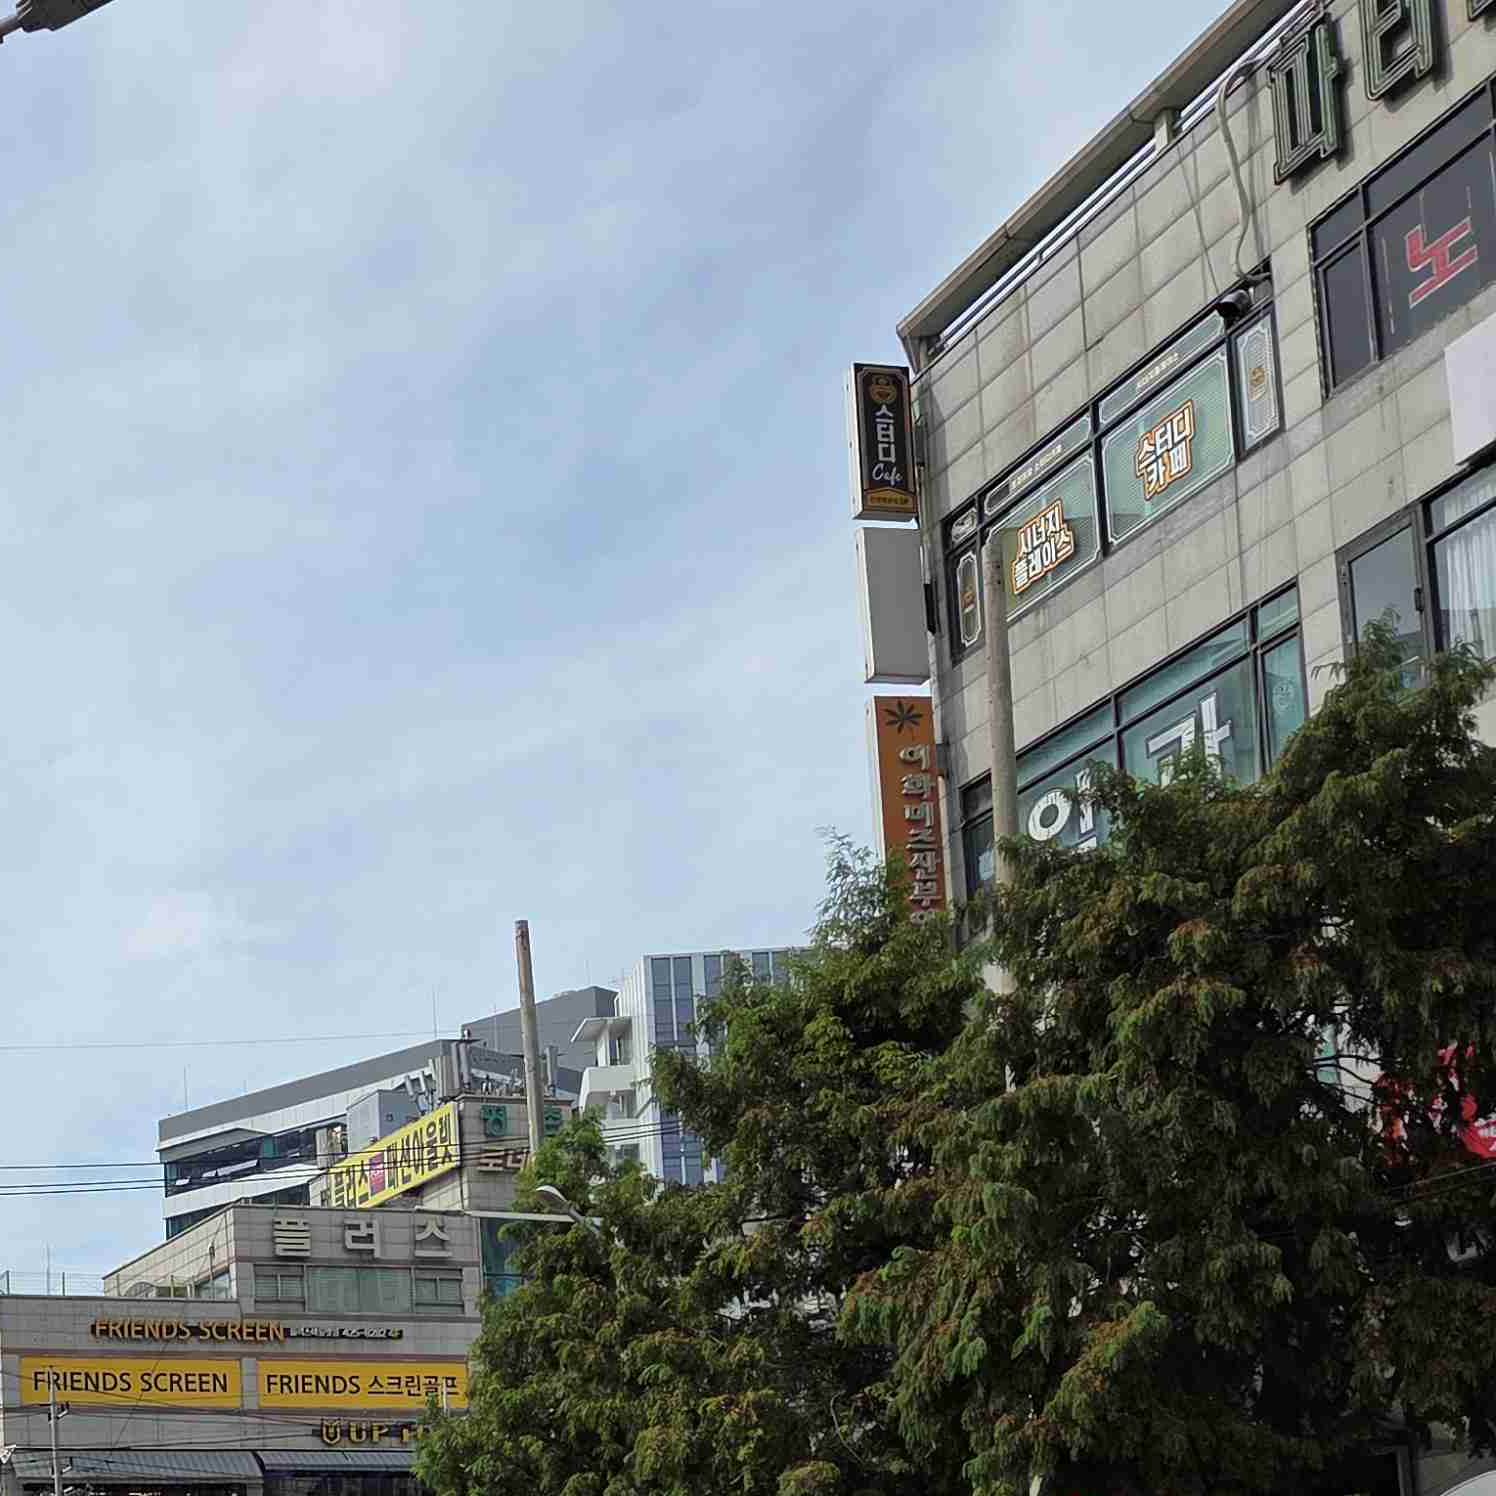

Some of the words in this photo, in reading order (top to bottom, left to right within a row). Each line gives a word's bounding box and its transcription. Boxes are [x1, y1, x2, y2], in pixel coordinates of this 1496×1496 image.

[874, 404, 897, 463] 스터디
[1138, 406, 1190, 470] 스터디
[872, 463, 903, 486] Cafe
[1145, 442, 1188, 493] 카페
[1020, 505, 1061, 554] 시너지
[1015, 529, 1072, 589] 플레이스
[273, 1216, 453, 1259] 플러스
[94, 1319, 191, 1341] FRIENDS
[199, 1319, 284, 1341] SCREEN
[34, 1371, 132, 1392] FRIENDS
[139, 1372, 228, 1393] SCREEN
[267, 1374, 361, 1394] FRIENDS
[367, 1375, 459, 1397] 스크린골프
